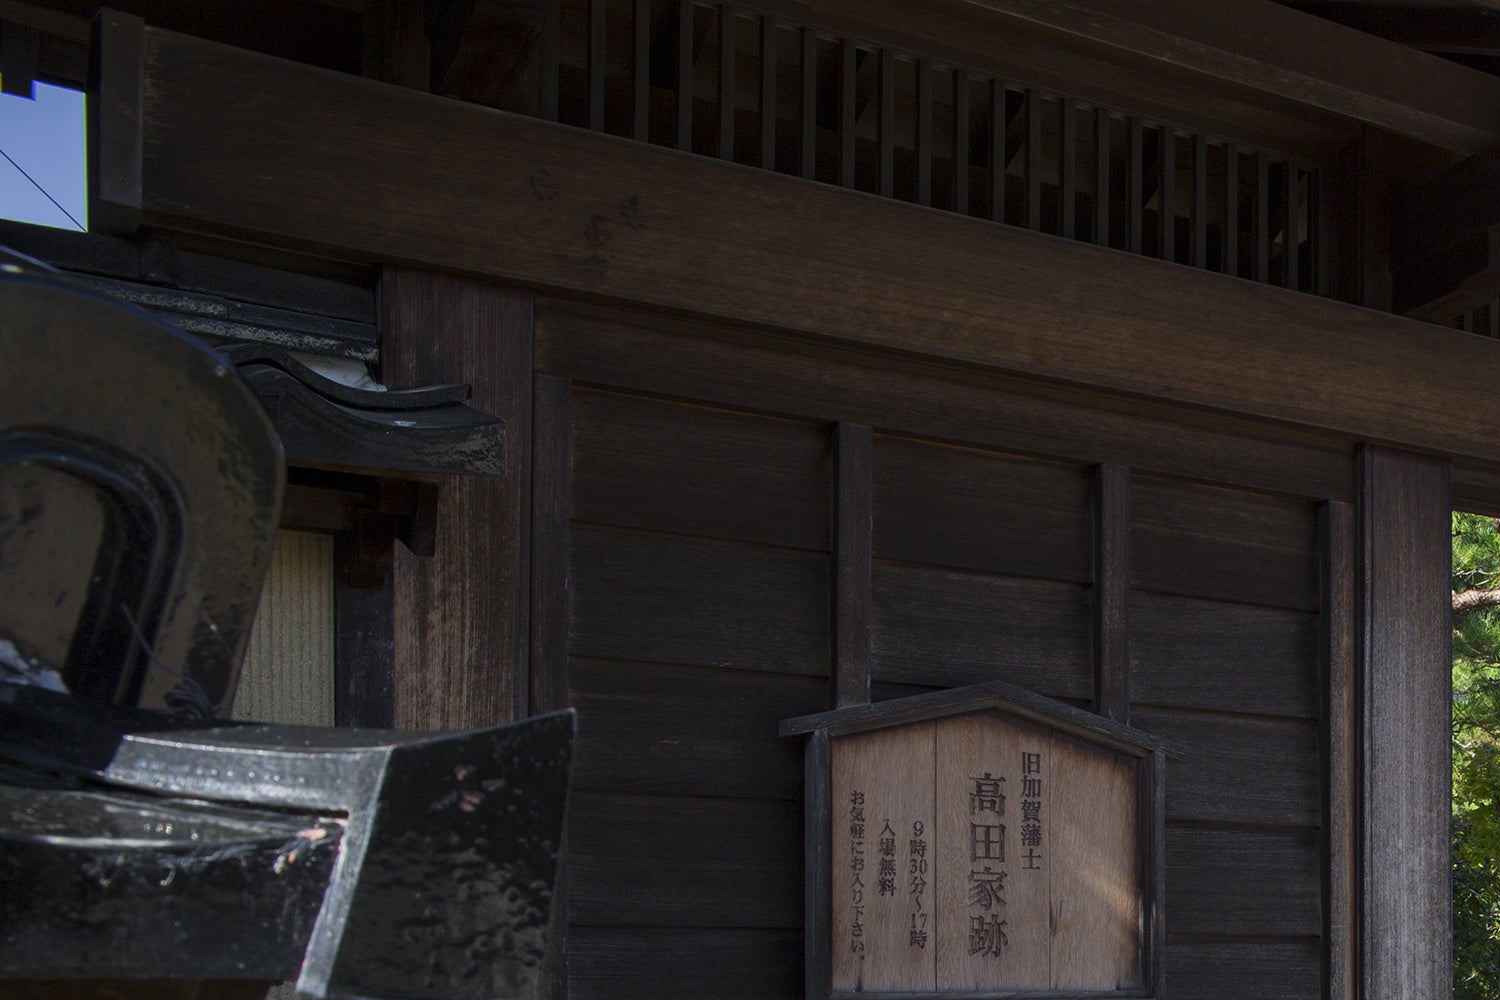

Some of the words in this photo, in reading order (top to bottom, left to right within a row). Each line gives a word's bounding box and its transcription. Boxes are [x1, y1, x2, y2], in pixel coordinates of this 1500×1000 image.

[849, 790, 866, 961] お気軽にお入り下さい。
[878, 819, 897, 897] 入場無料
[967, 772, 1009, 958] 高田家跡
[1020, 751, 1042, 871] 旧加賀藩士
